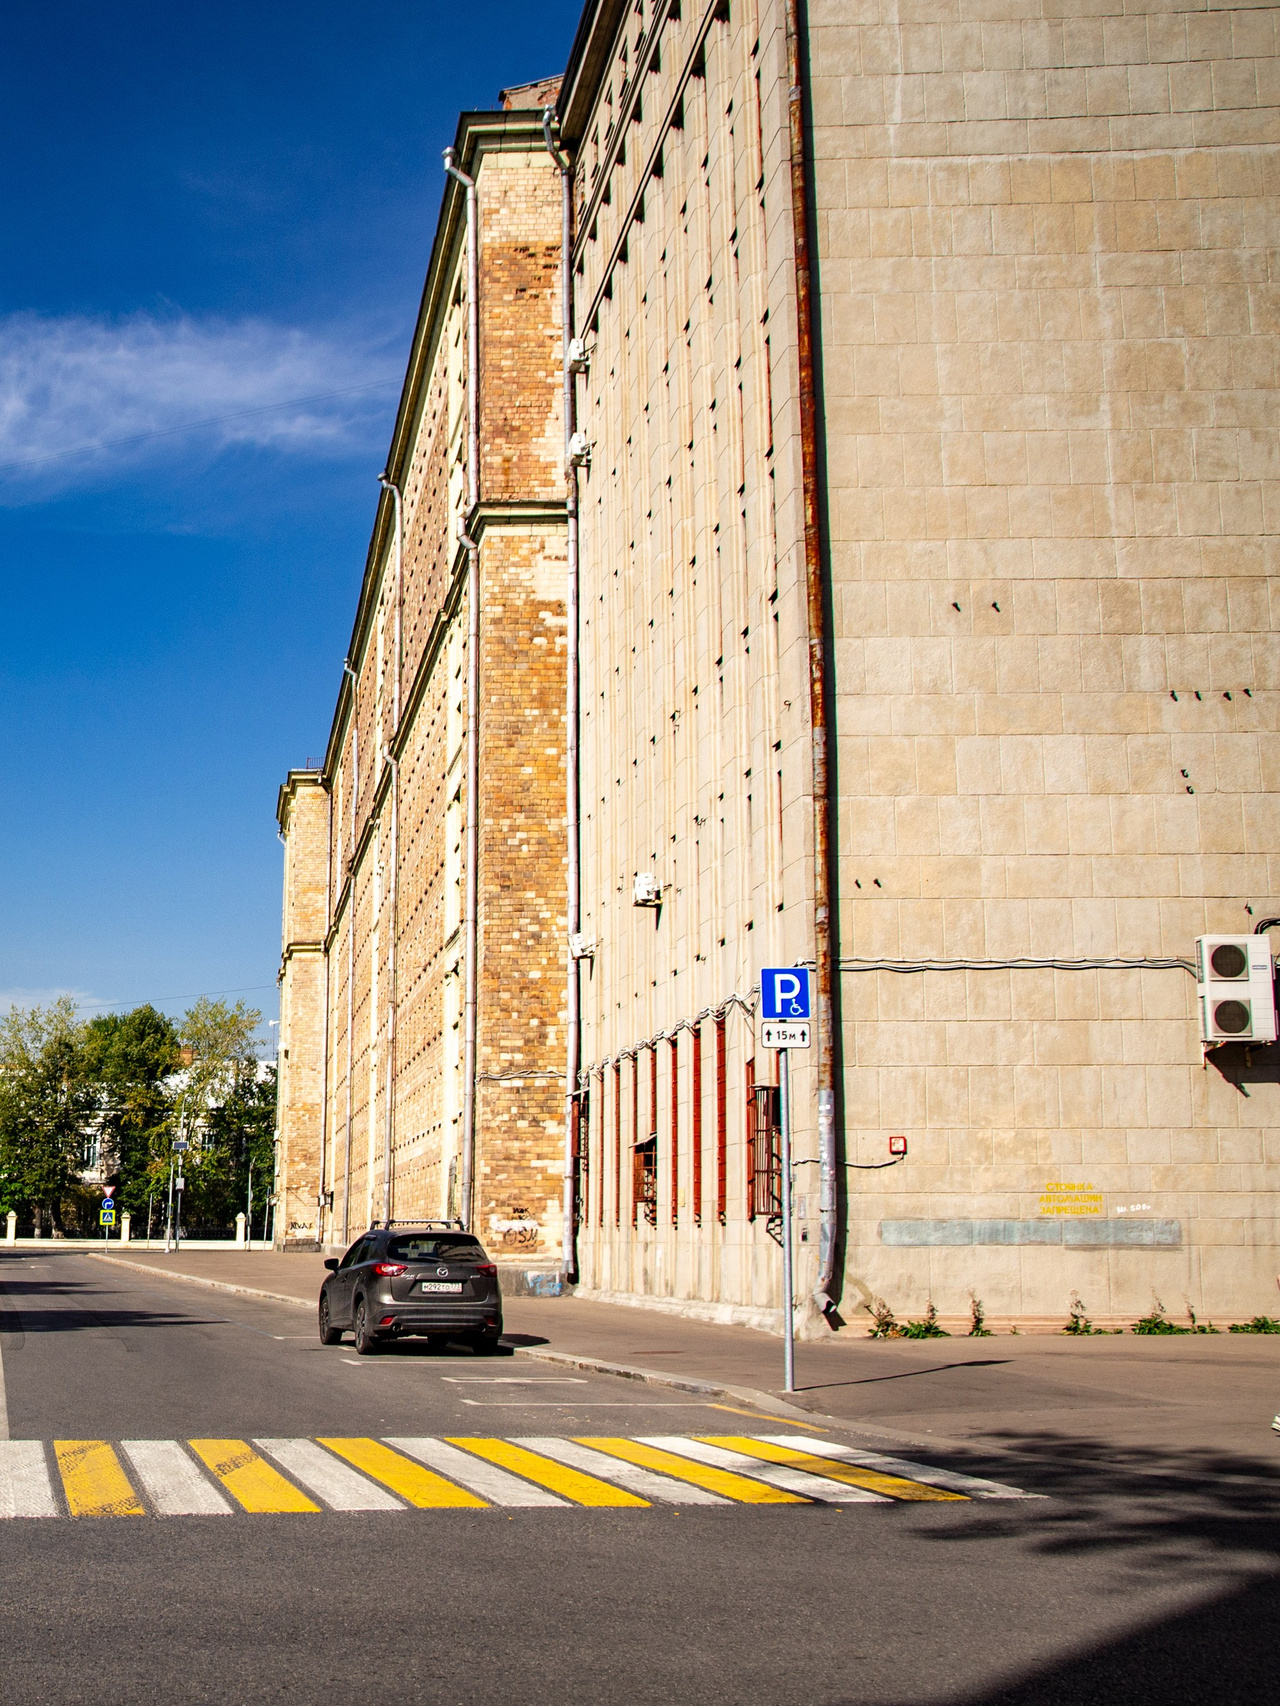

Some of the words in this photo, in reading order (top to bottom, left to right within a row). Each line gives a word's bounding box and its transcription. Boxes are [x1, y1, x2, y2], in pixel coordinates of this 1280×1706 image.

[774, 973, 801, 1013] P
[1045, 1182, 1094, 1192] СТОЯНКА
[1039, 1194, 1103, 1203] АВТОМАШИН
